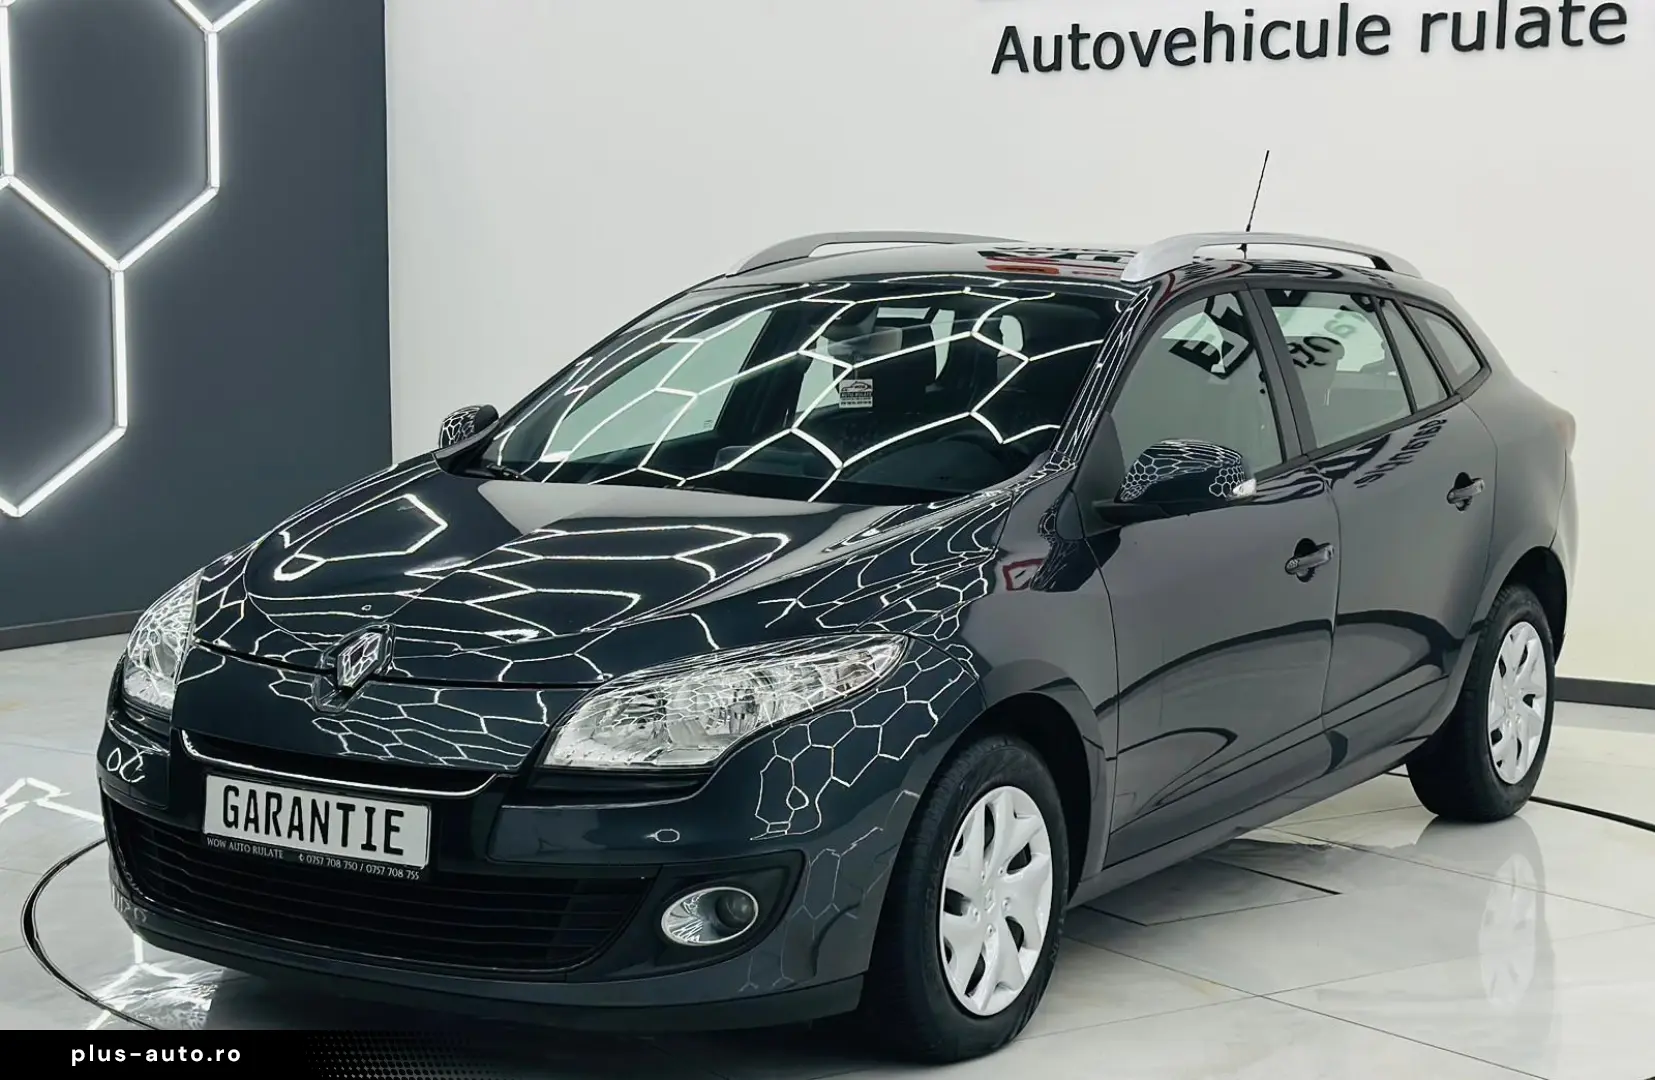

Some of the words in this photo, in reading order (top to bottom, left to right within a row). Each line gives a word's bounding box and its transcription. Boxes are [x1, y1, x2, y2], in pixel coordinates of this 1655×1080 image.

[991, 2, 1391, 75] Autovehicule
[1420, 0, 1627, 53] rulate
[222, 784, 405, 856] GARANTIE
[207, 836, 227, 848] WOW
[228, 841, 251, 853] AUTO
[252, 845, 284, 859] RULATE
[306, 855, 324, 866] 0757
[326, 857, 341, 868] 708
[343, 860, 358, 871] 750
[366, 864, 385, 876] 0757
[387, 867, 404, 878] 708
[406, 869, 420, 880] 755
